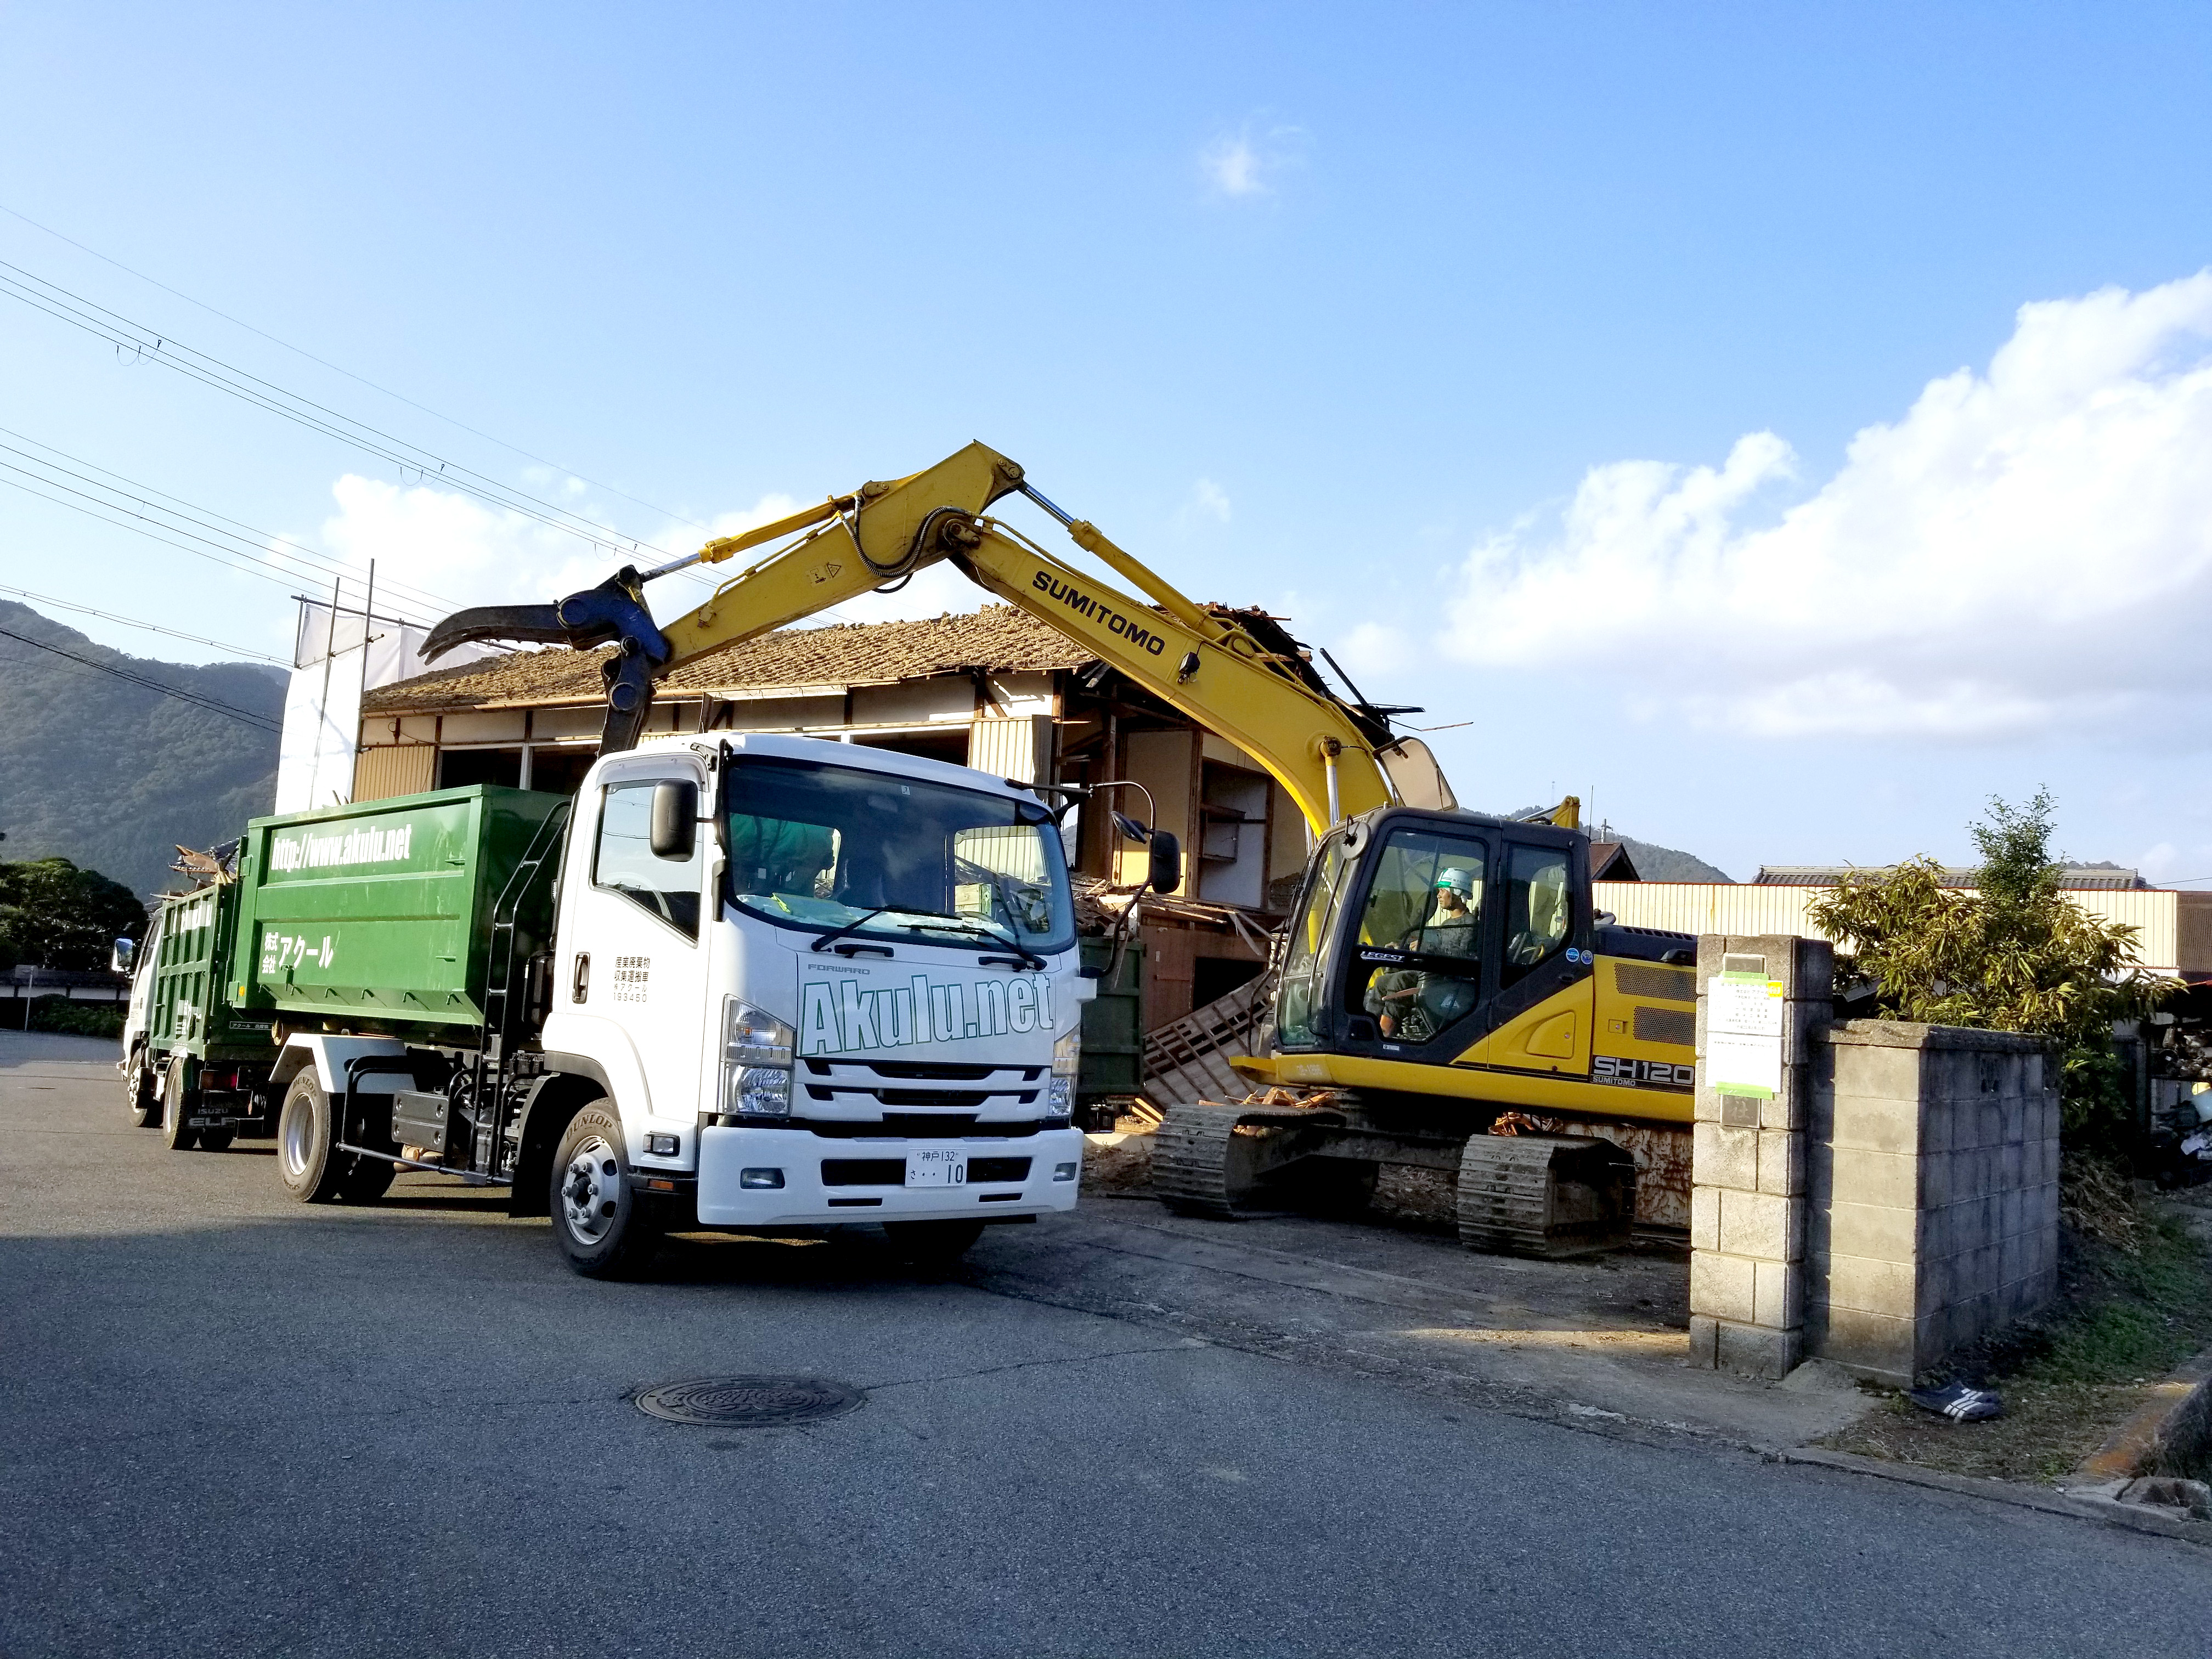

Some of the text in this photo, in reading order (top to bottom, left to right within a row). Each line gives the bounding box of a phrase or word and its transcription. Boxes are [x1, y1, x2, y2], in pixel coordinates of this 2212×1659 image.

[1032, 571, 1165, 656] SUMITOMO
[271, 824, 411, 872] http://www.akulu.net
[279, 935, 334, 969] アクール
[1360, 951, 1405, 962] LEGEST
[615, 956, 650, 969] 産業廃棄物
[808, 964, 870, 975] FORWARD
[614, 970, 648, 983] 収集運搬車
[614, 992, 647, 1002] 193450
[799, 973, 1054, 1057] Akulu.net
[1593, 1056, 1695, 1085] SH120
[1593, 1076, 1636, 1086] SUMITOMO
[189, 1116, 235, 1126] ELF
[566, 1114, 613, 1141] DUNLOP
